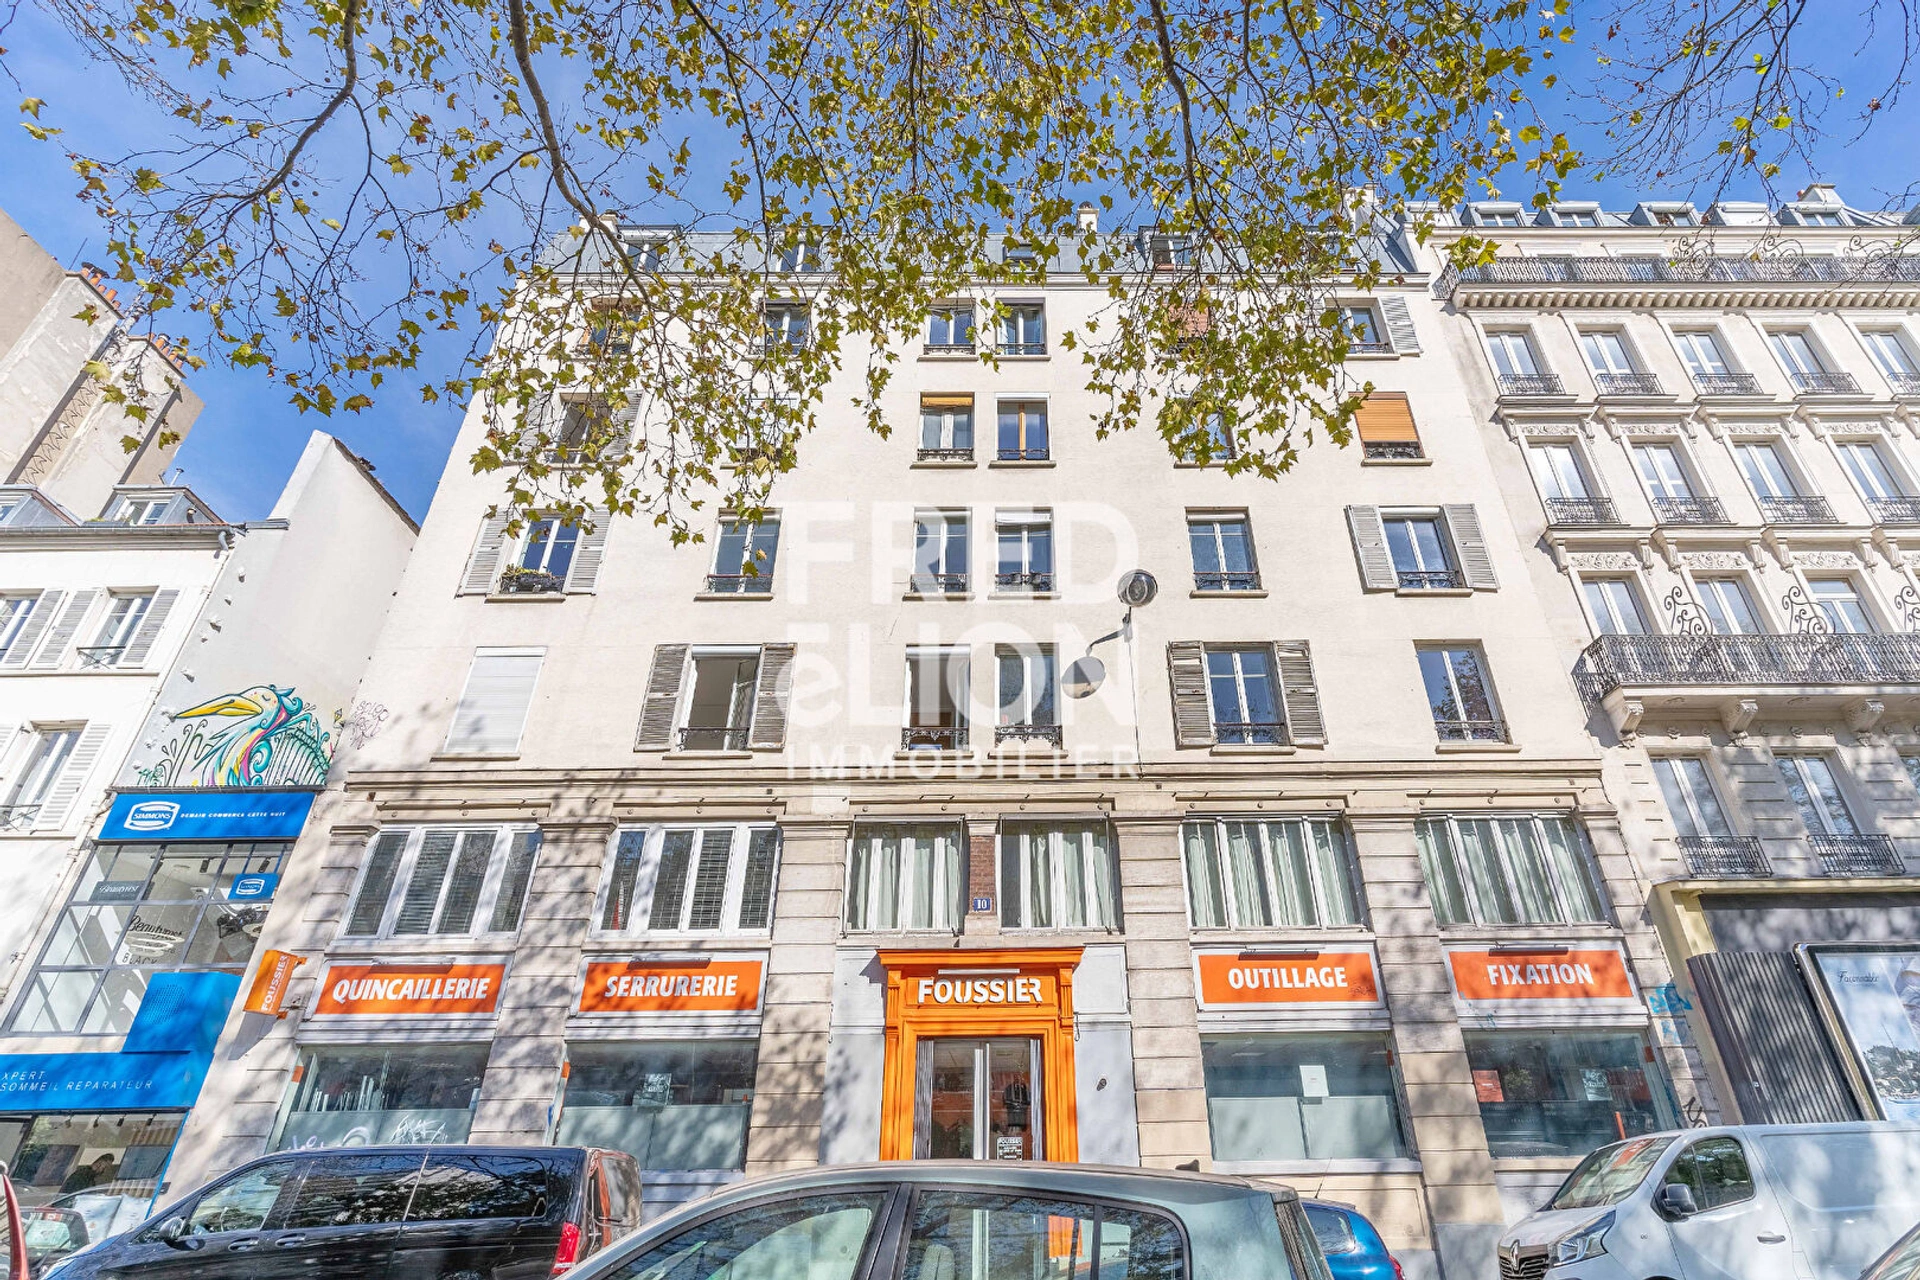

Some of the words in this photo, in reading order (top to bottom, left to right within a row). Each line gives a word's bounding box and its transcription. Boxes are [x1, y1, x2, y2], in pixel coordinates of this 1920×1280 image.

[977, 899, 988, 910] 10
[261, 955, 288, 1011] FOUSSIER
[604, 975, 738, 997] SERRURERIE
[1228, 966, 1348, 989] OUTILLAGE
[1486, 963, 1594, 986] FIXATION
[332, 978, 491, 1004] QUINCAILLERIE
[918, 978, 1043, 1004] FOUSSIER
[0, 1082, 59, 1092] SOMMEIL
[66, 1080, 153, 1091] REPARATEUR
